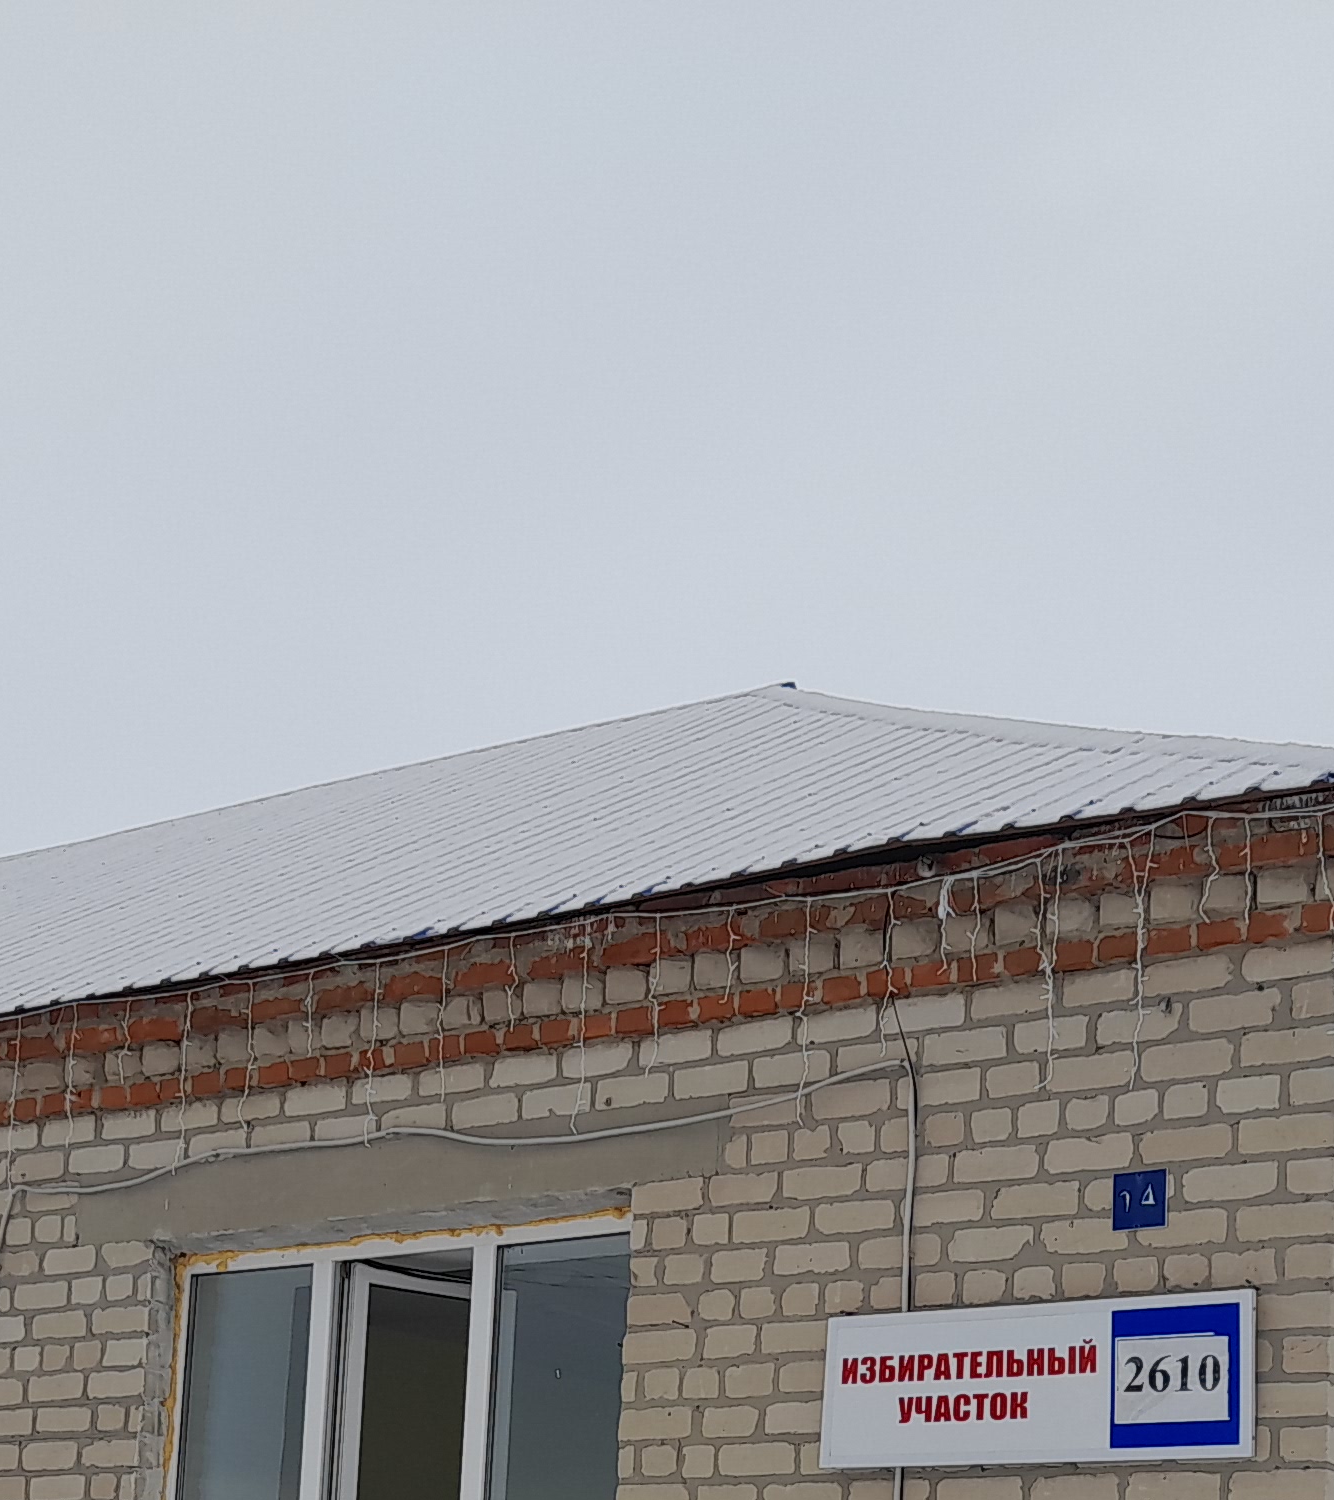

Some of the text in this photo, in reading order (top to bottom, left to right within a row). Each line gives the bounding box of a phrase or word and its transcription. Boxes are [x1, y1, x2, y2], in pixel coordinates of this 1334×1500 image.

[840, 1338, 1098, 1385] ИЗБИРАТЕЛЬНЫЙ
[1122, 1353, 1221, 1394] 2610
[898, 1391, 1029, 1424] УЧАСТОК
